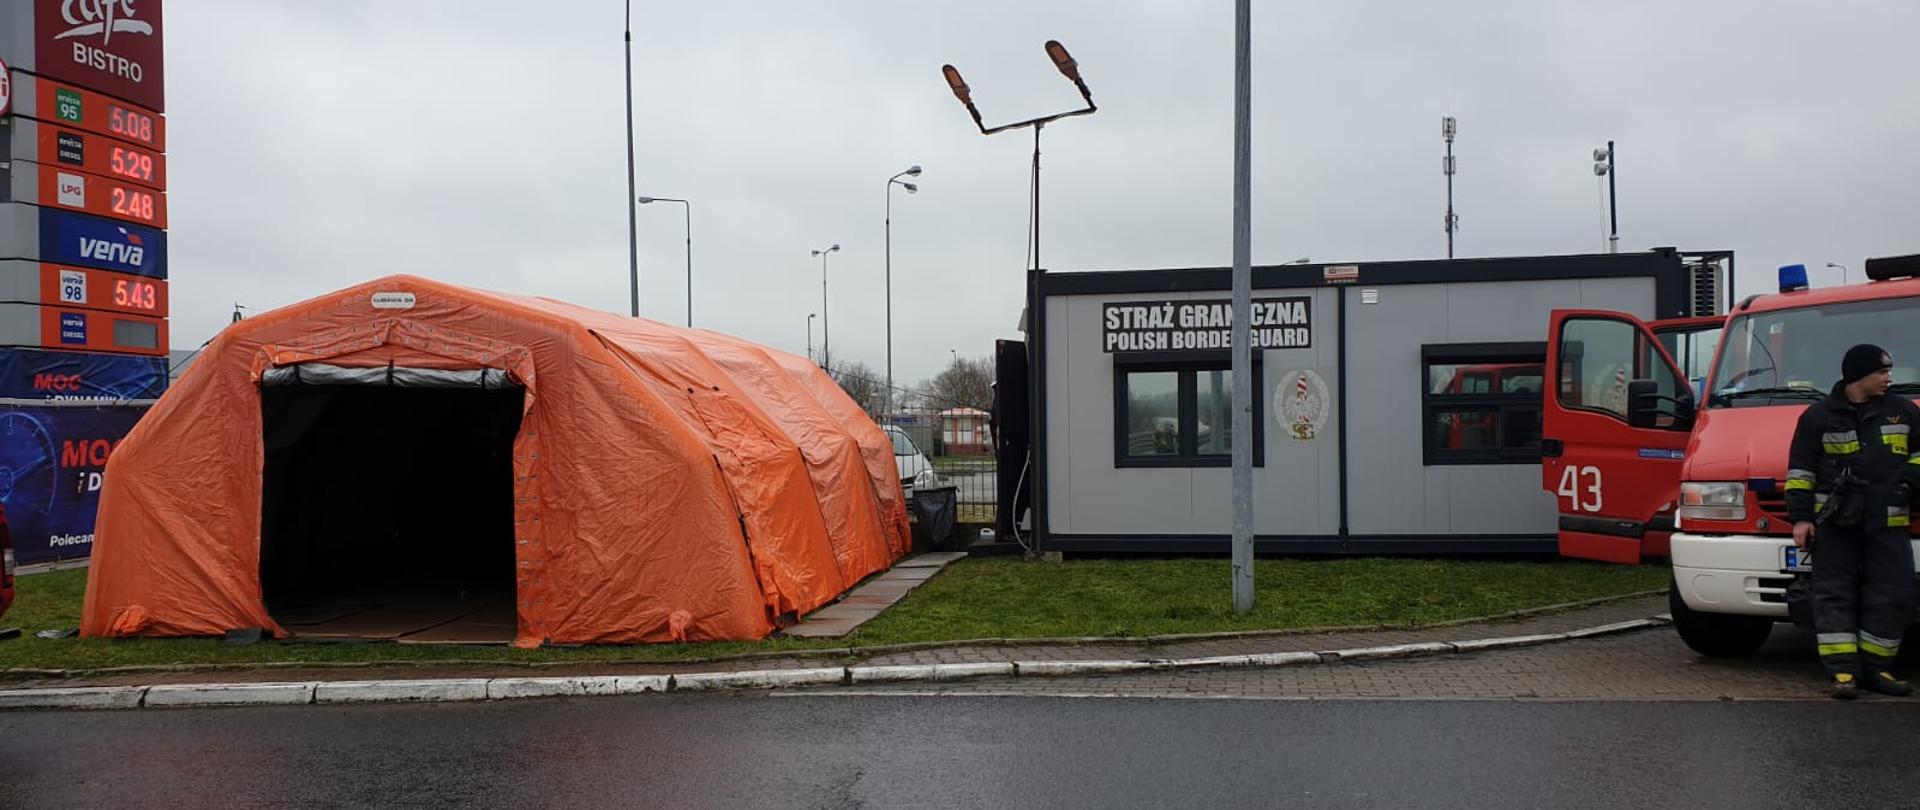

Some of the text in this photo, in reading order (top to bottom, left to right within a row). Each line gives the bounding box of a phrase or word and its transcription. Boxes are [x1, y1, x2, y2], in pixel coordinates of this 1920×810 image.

[73, 42, 143, 83] BISTRO
[60, 104, 78, 119] 95
[111, 107, 152, 142] 5.08
[111, 147, 153, 180] 5.29
[61, 184, 81, 196] LPG
[112, 187, 154, 220] 2.48
[80, 237, 144, 266] verva
[65, 286, 82, 300] 98
[115, 280, 156, 309] 5.43
[1106, 301, 1308, 329] STRAŻ GRANCZNA
[1106, 328, 1309, 350] POLISH BORDE GUARD
[33, 373, 81, 391] MOC
[62, 439, 125, 468] MO
[1558, 465, 1603, 512] 43
